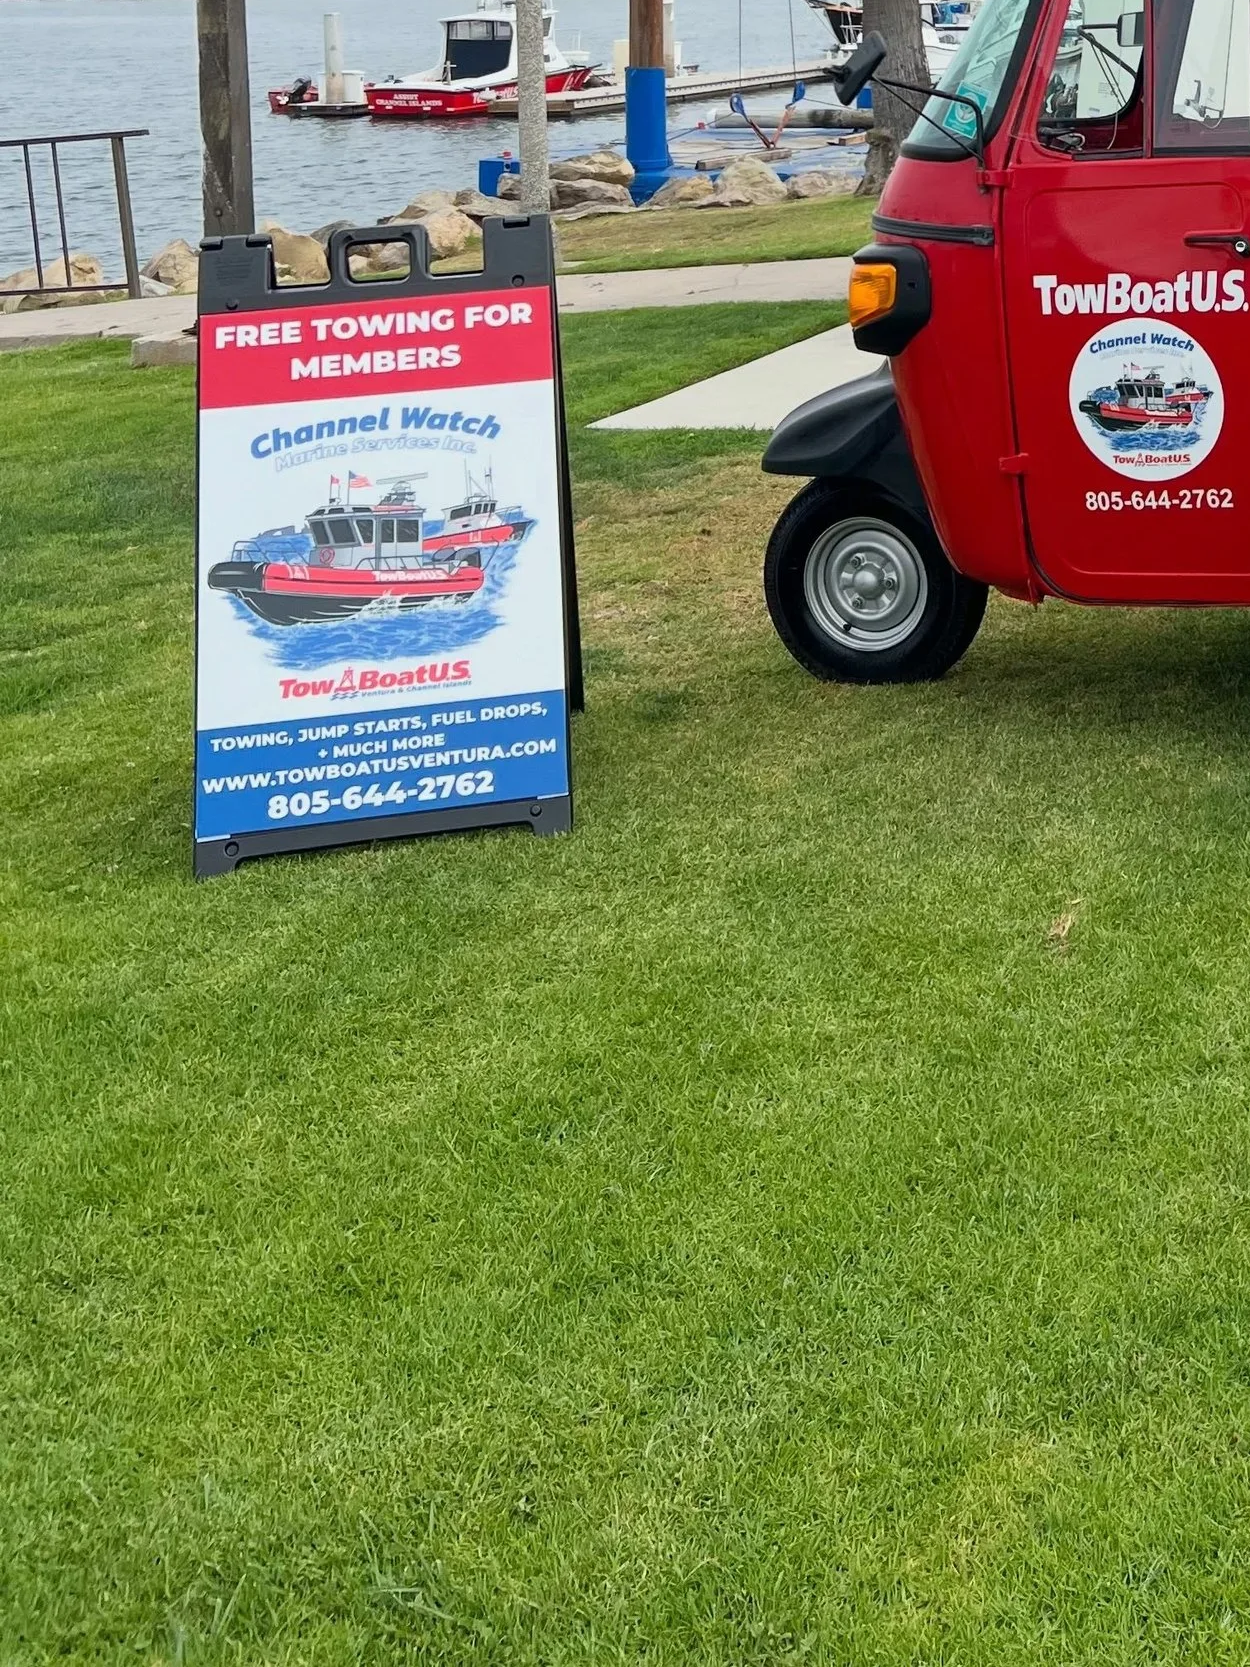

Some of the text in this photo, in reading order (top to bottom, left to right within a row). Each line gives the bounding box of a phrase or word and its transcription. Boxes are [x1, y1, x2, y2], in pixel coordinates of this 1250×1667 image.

[215, 303, 533, 349] FREE TOWING FOR
[1090, 333, 1146, 354] Channel
[1150, 333, 1195, 352] Watch
[290, 345, 462, 380] MEMBERS
[250, 407, 501, 459] Channel Watch
[274, 433, 477, 472] Marine Services Inc.
[1113, 455, 1135, 464] Tow
[1085, 489, 1234, 511] 805-644-2762
[279, 678, 335, 699] Tow
[361, 688, 396, 697] Ventura
[406, 683, 441, 692] Channel
[442, 680, 472, 688] Islands
[210, 702, 547, 752] TOWING, JUMP STARTS, FUEL DROPS,
[318, 734, 445, 759] + MUCH MORE
[202, 739, 556, 794] WWW.TOWBOATUSVENTURA.COM
[267, 771, 495, 819] 805-644-2762
